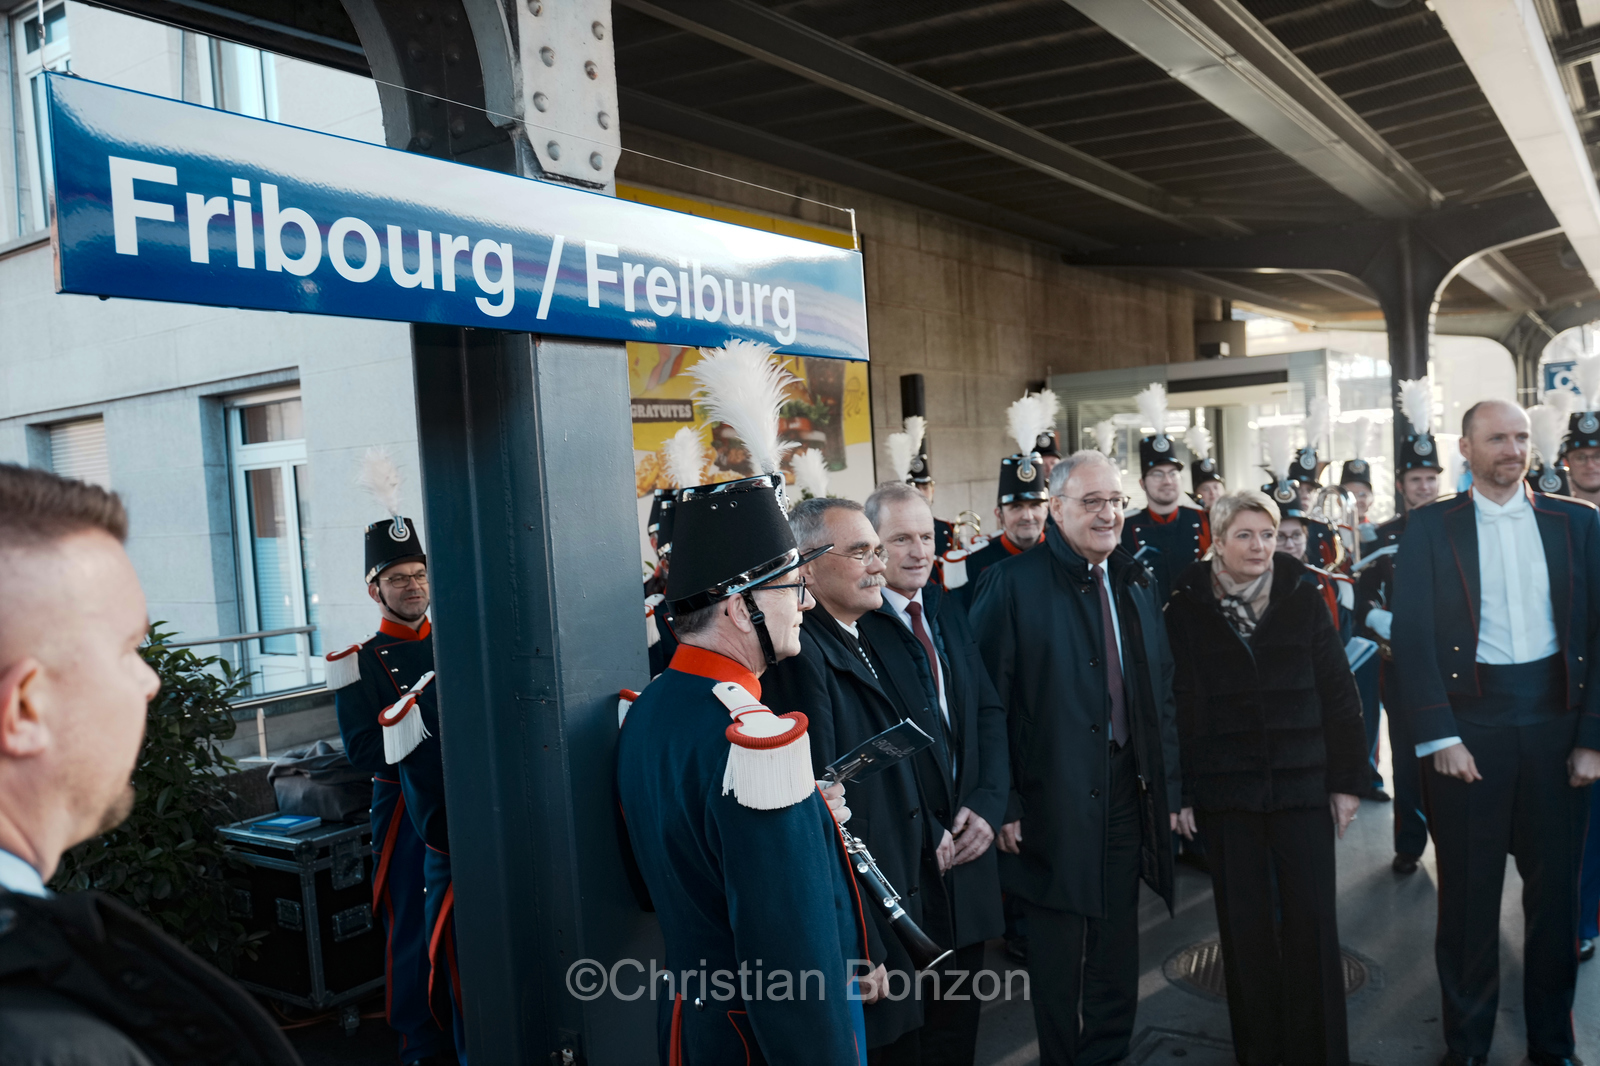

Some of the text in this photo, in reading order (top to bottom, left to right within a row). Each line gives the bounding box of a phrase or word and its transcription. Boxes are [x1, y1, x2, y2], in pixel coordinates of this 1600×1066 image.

[108, 155, 796, 346] Fribourg / Freiburg
[631, 404, 692, 418] GRATUITES
